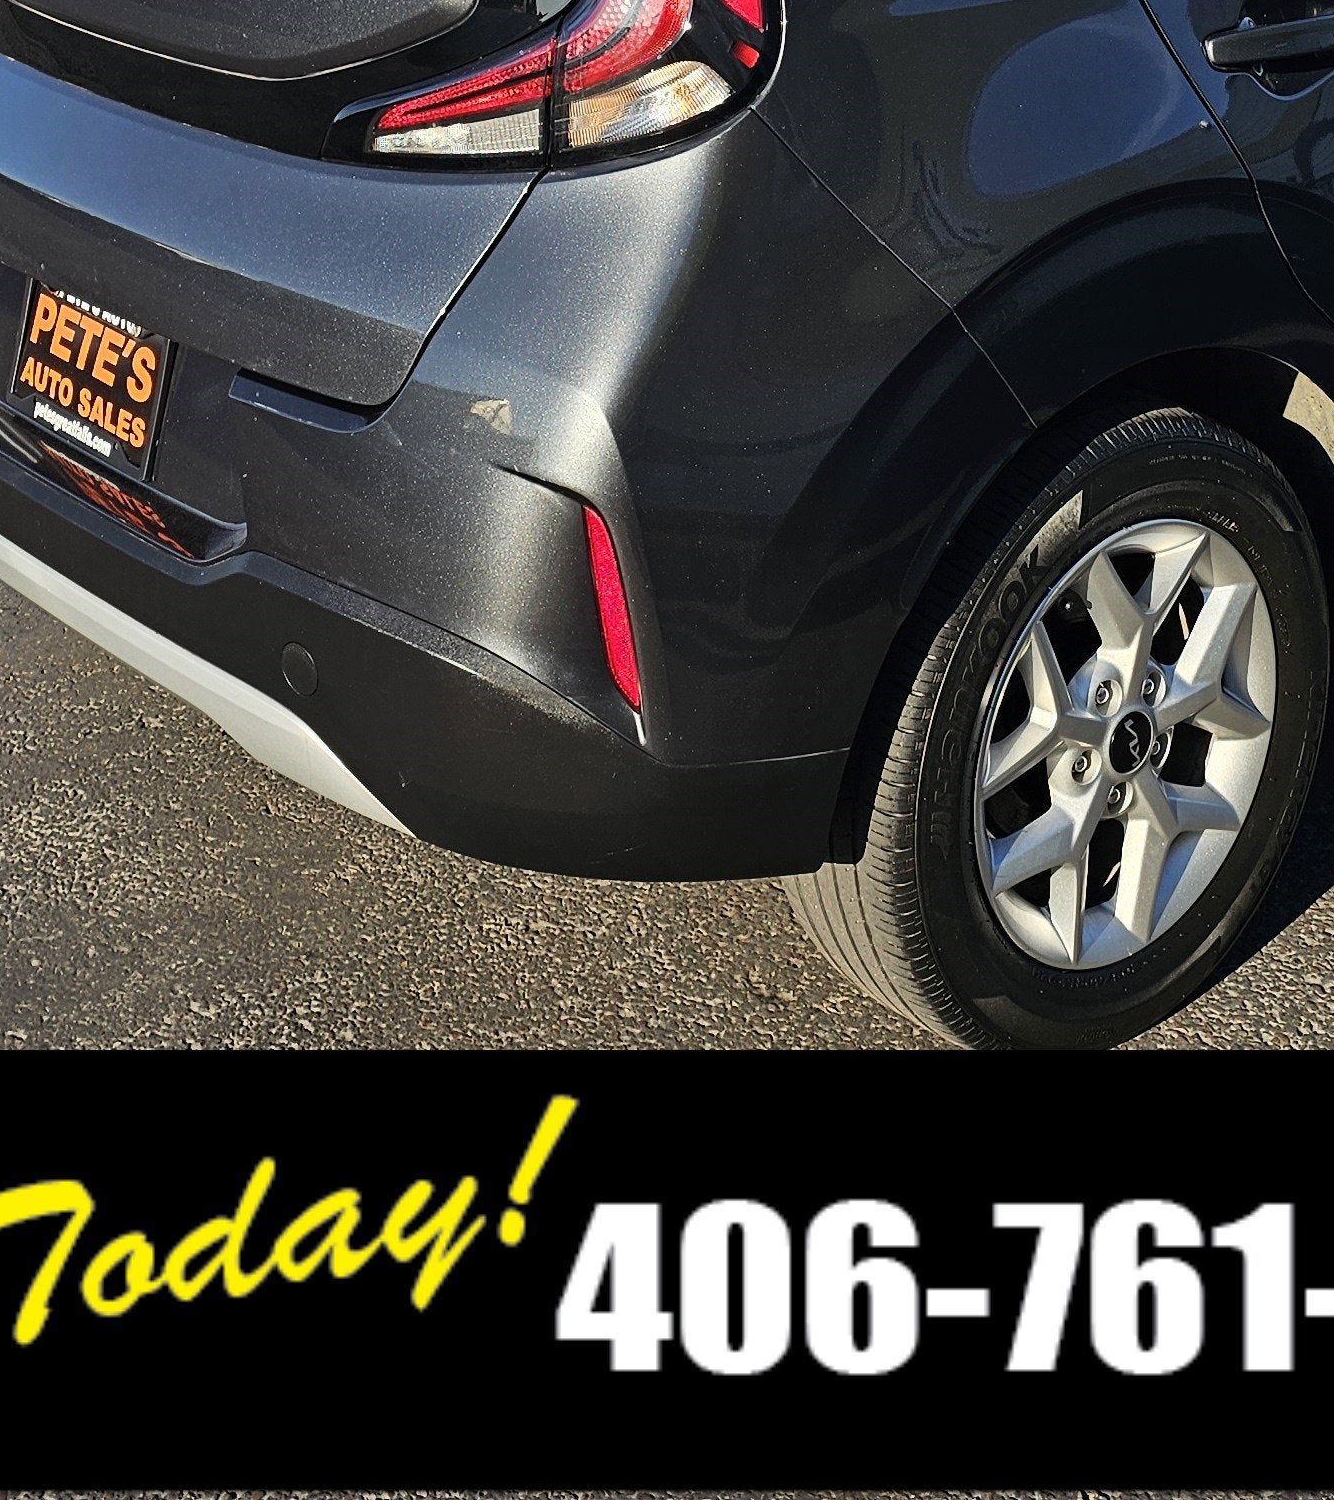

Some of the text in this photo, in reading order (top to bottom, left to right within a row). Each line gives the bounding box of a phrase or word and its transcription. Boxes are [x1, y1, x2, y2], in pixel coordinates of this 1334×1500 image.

[29, 292, 157, 403] PETE'S
[20, 356, 146, 449] AUTO SALES
